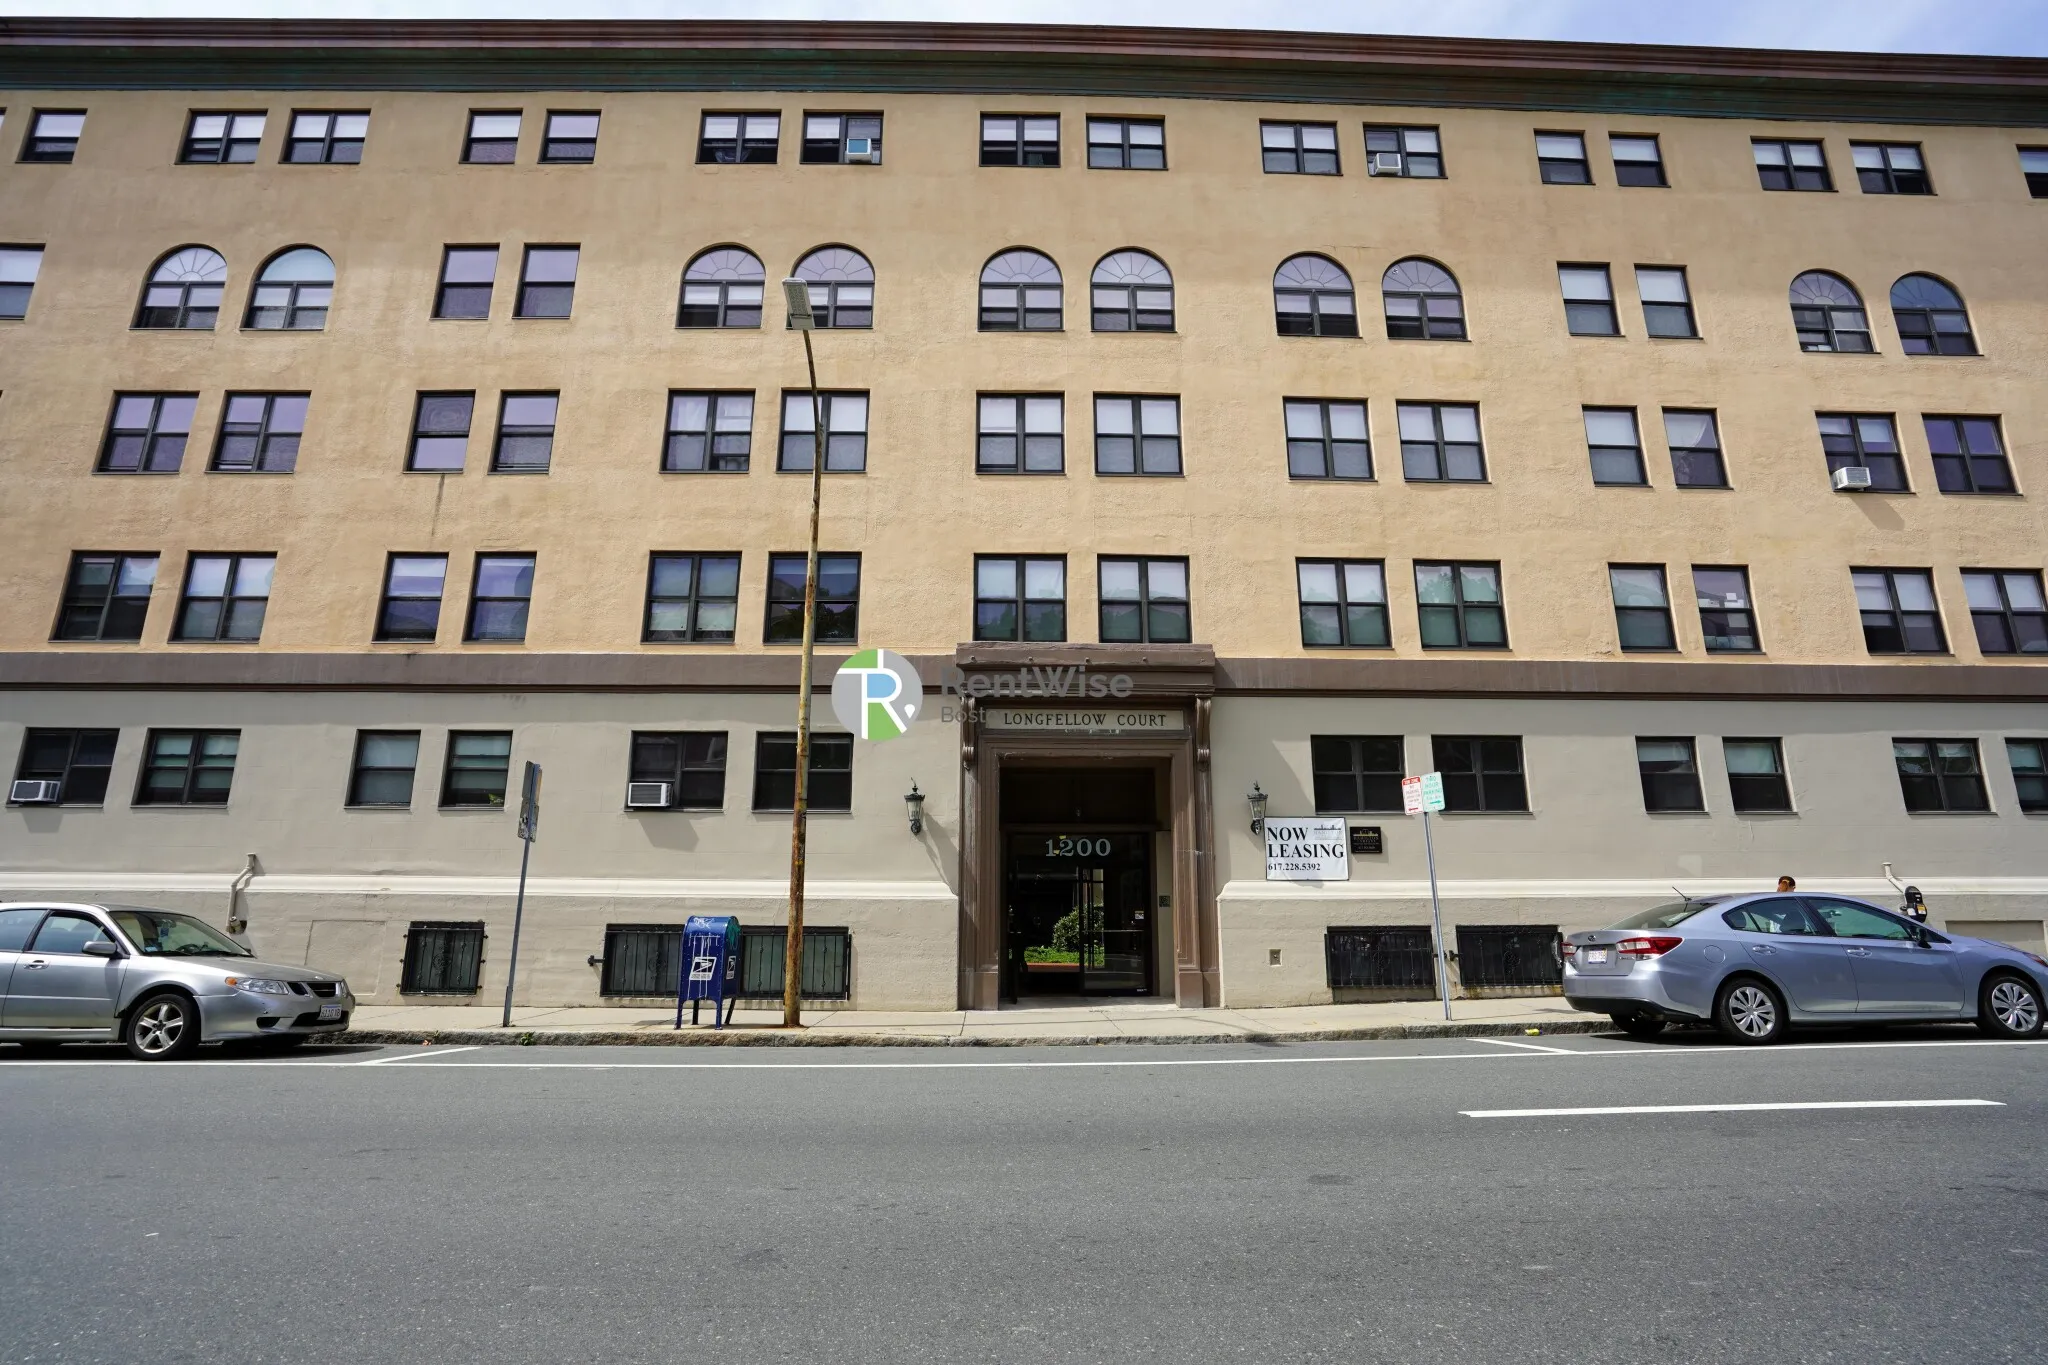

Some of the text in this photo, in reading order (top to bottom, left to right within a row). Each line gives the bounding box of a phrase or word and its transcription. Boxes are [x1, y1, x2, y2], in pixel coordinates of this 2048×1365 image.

[1004, 712, 1167, 727] LONGFELLOW COURT
[1267, 827, 1308, 841] NOW
[1045, 838, 1111, 857] 1200
[1268, 843, 1344, 859] LEASING
[1268, 863, 1321, 871] 617.228.5392
